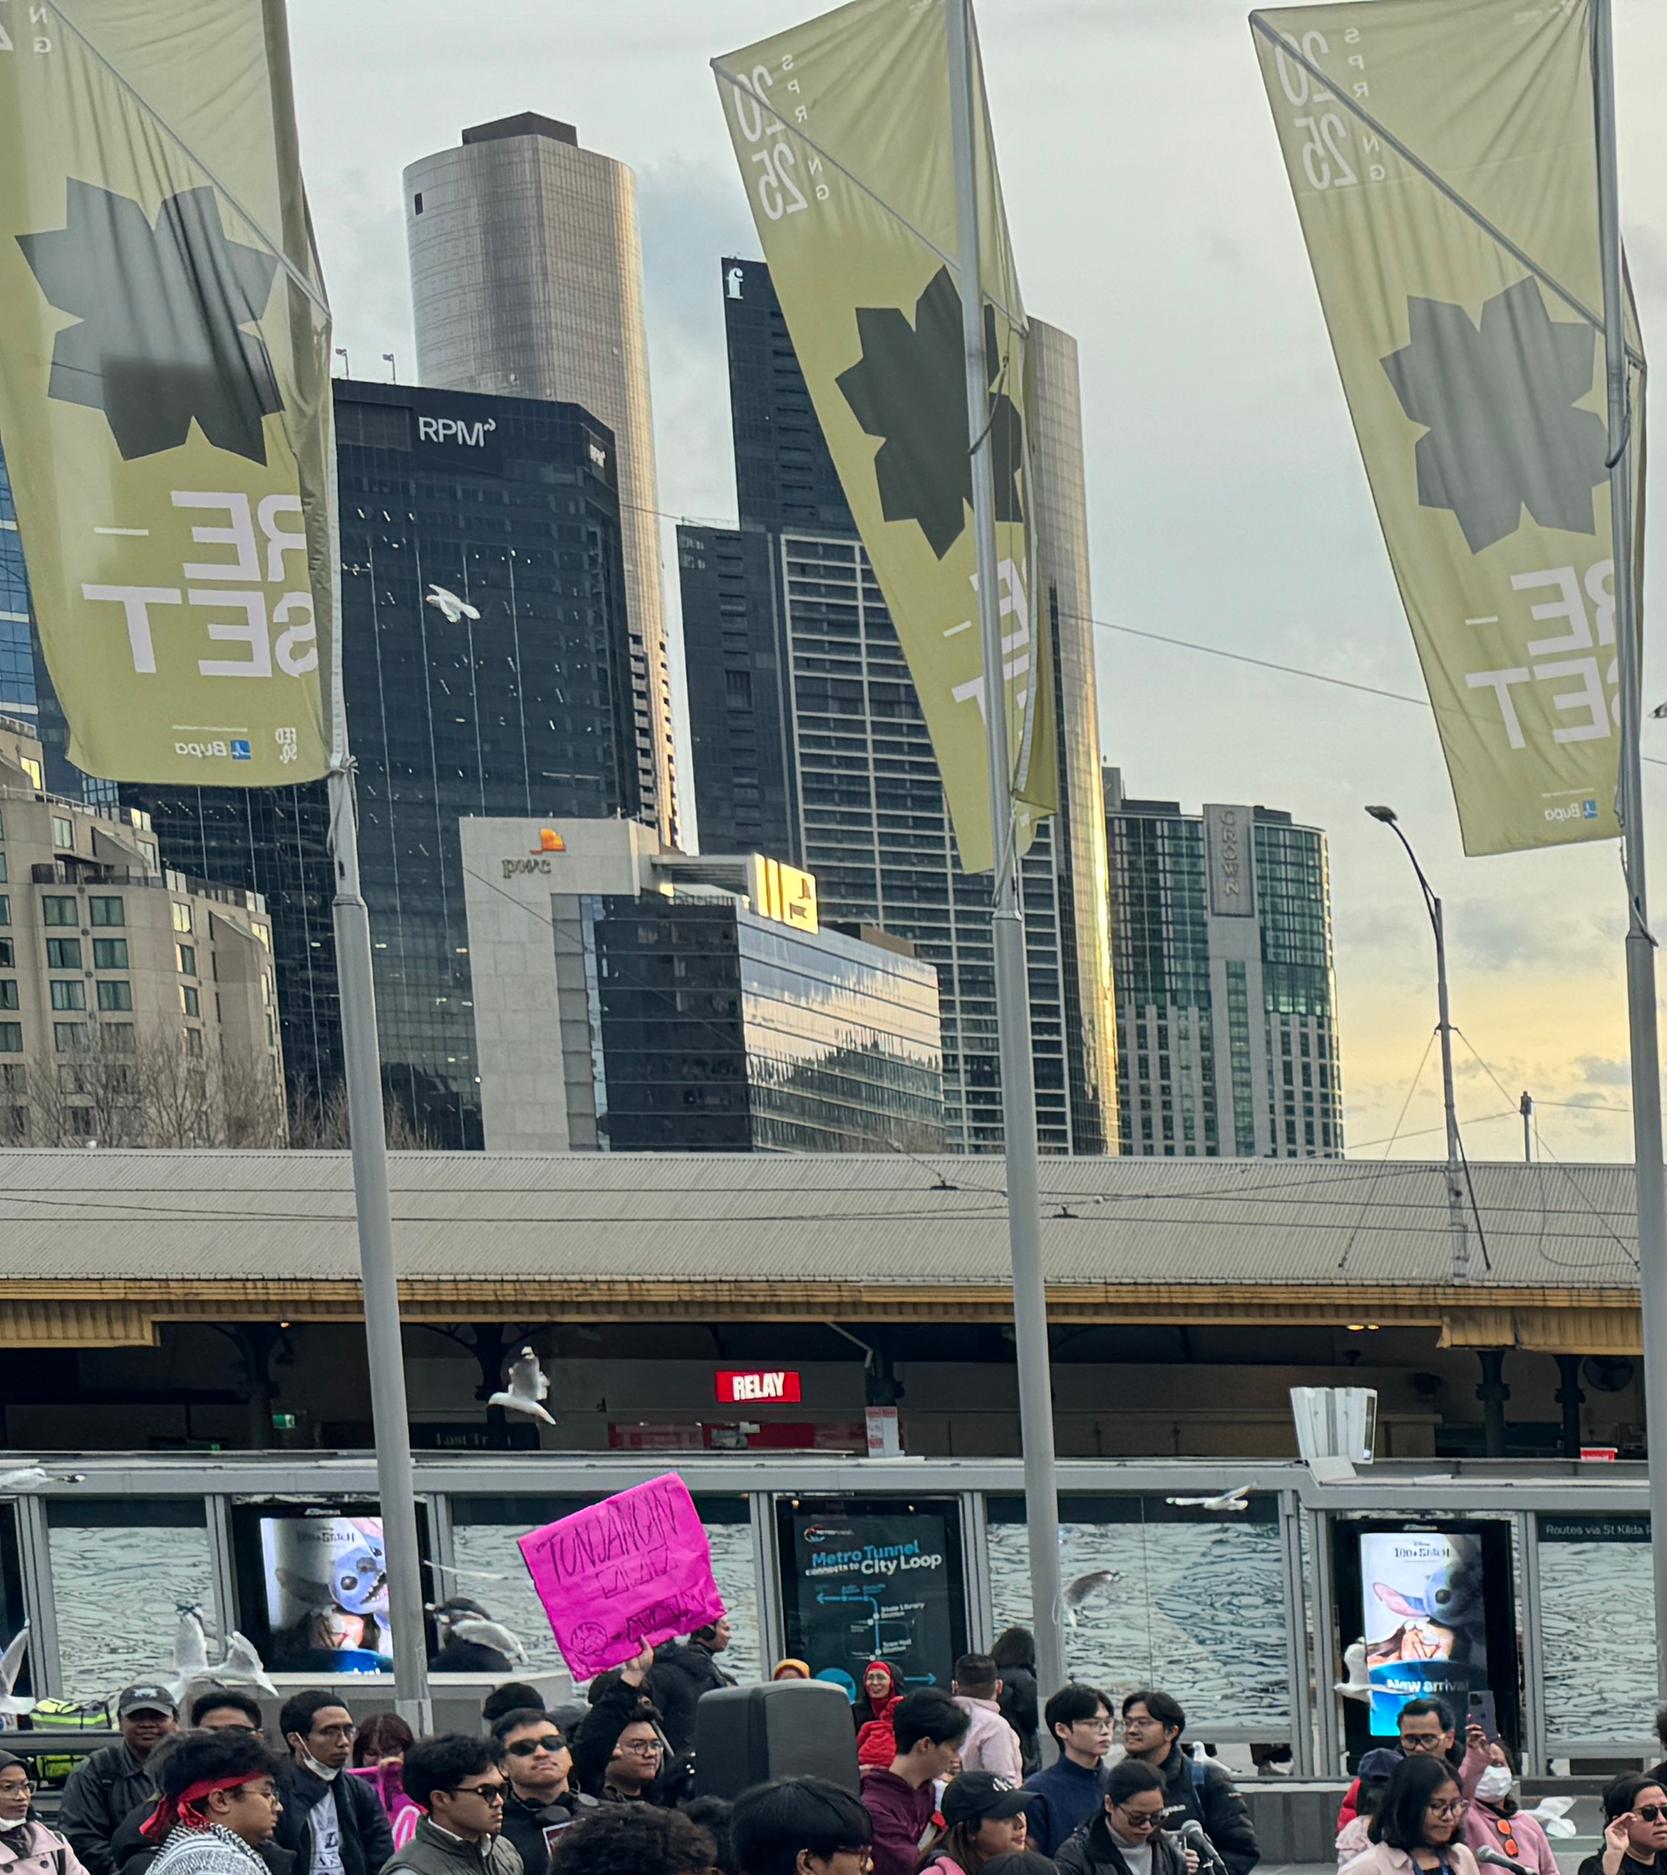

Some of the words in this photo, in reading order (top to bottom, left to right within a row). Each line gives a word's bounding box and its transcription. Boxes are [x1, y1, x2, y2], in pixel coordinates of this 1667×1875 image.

[418, 416, 485, 448] RPM
[1221, 810, 1239, 896] CROWN
[502, 858, 552, 879] pwc
[732, 1372, 785, 1401] RELAY
[1546, 1525, 1583, 1535] Routes
[1586, 1525, 1600, 1535] via
[1603, 1525, 1615, 1535] St
[1618, 1524, 1643, 1535] Kilda
[812, 1551, 862, 1567] Metro
[864, 1540, 919, 1559] Tunnel
[861, 1557, 897, 1576] City
[901, 1554, 942, 1570] Loop
